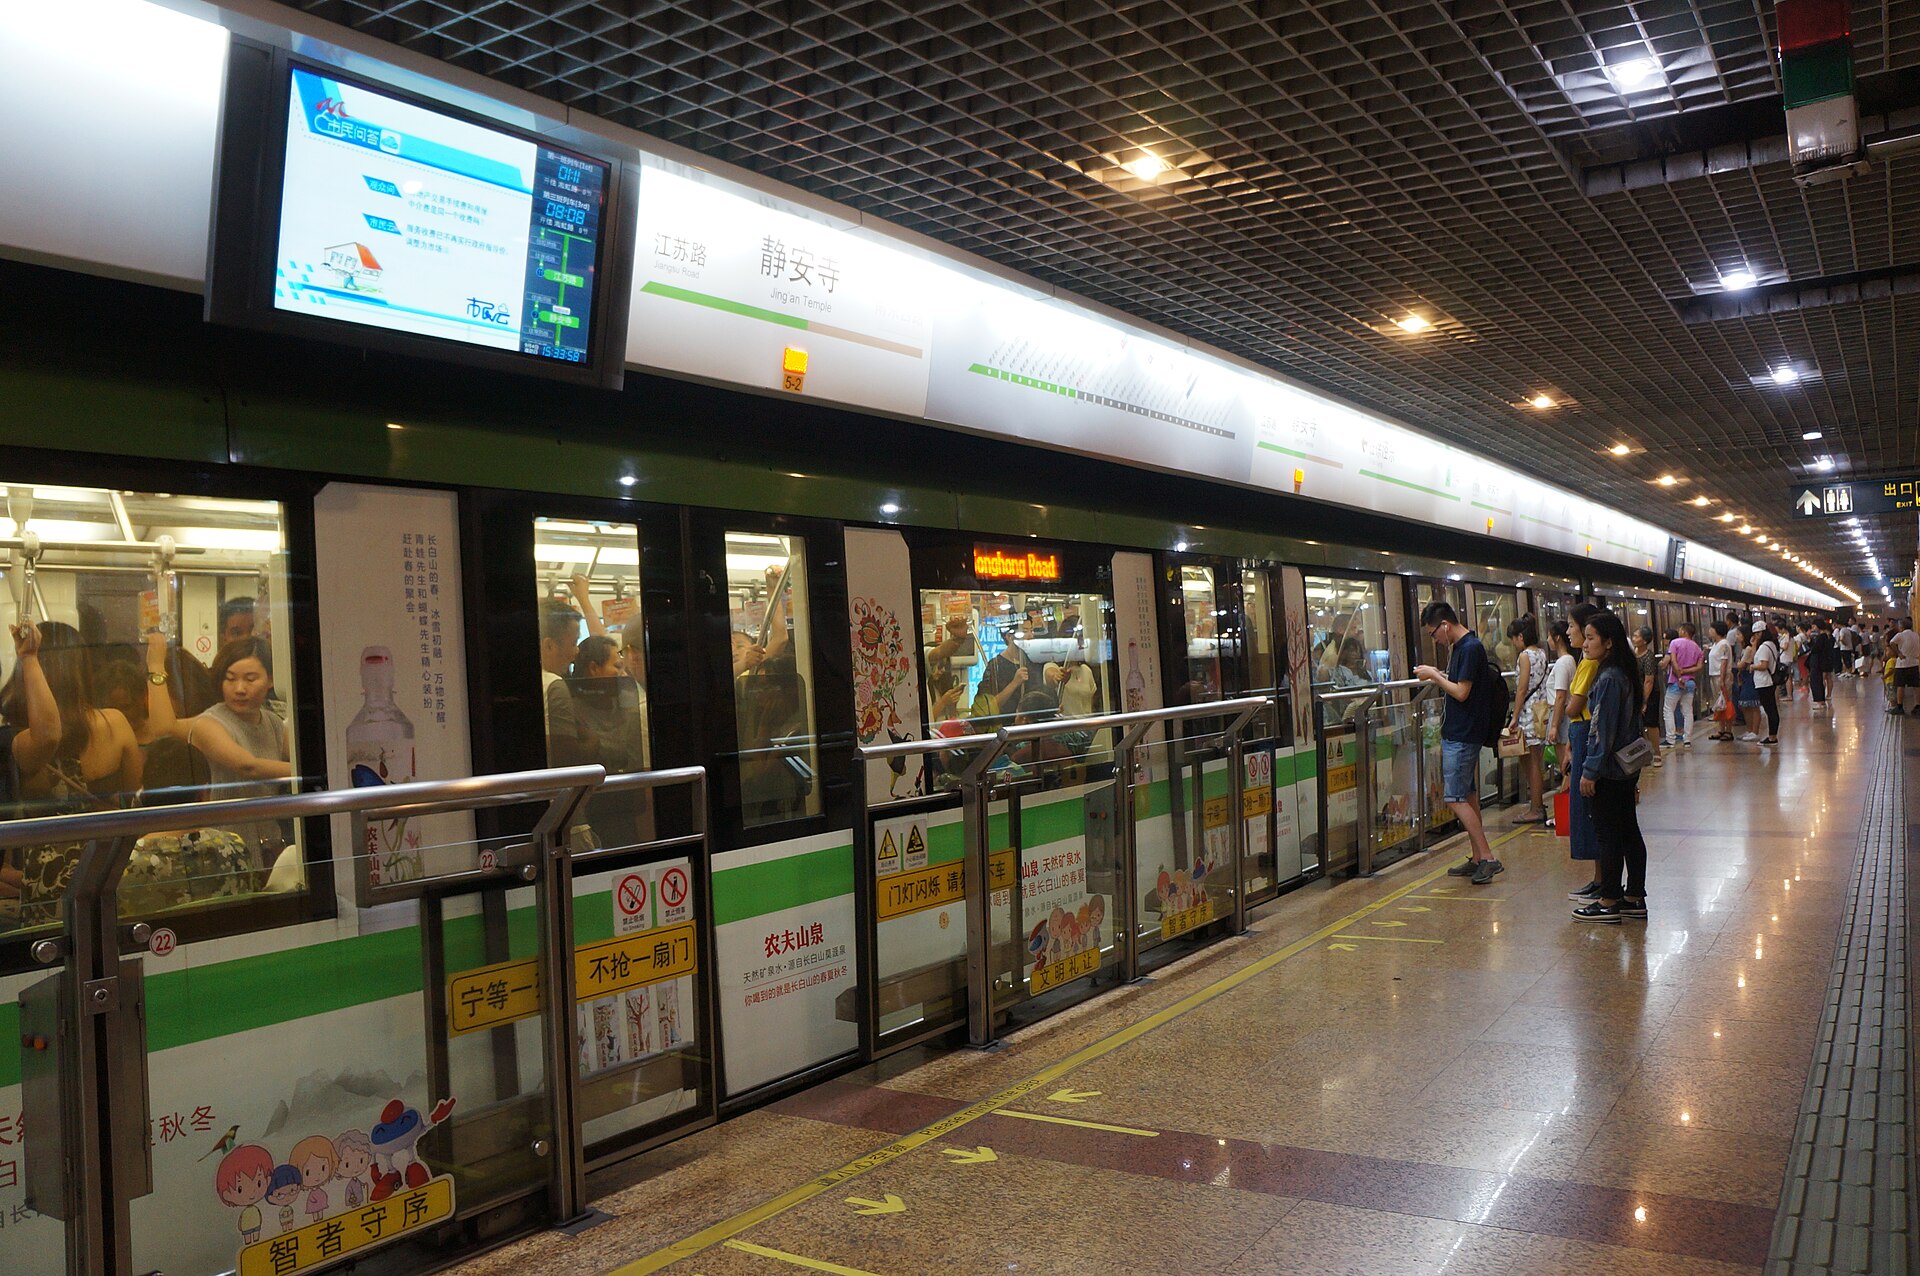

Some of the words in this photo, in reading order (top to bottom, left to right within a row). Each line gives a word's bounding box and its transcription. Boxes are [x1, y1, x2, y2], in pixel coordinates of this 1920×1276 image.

[327, 119, 380, 146] 市民问答
[369, 180, 396, 195] 观众问
[369, 217, 396, 232] 市民云
[545, 202, 586, 226] 08:08
[654, 232, 707, 268] 江苏路
[653, 259, 680, 274] Jiangsu
[681, 266, 701, 280] Road
[760, 234, 840, 294] 静安寺
[770, 287, 800, 305] Jing'an
[803, 294, 833, 313] Temple
[542, 346, 580, 362] 15:33:58
[784, 375, 802, 391] 5-2
[1884, 482, 1913, 496] 出口
[1896, 500, 1913, 508] EXIT
[974, 551, 1027, 578] onghong
[1027, 553, 1057, 578] Road
[481, 854, 493, 868] 22
[1043, 850, 1082, 873] 天然矿泉水
[888, 877, 941, 907] 门灯闪烁
[155, 934, 172, 951] 22
[764, 921, 825, 958] 农夫山泉
[461, 972, 541, 1018] 宁等一
[589, 937, 689, 984] 不抢一扇门
[1039, 954, 1094, 989] 文明礼让
[744, 965, 849, 1007] 你喝到的就是长白山的春夏秋冬
[150, 1105, 216, 1147] 秋冬
[269, 1192, 428, 1275] 智者守序
